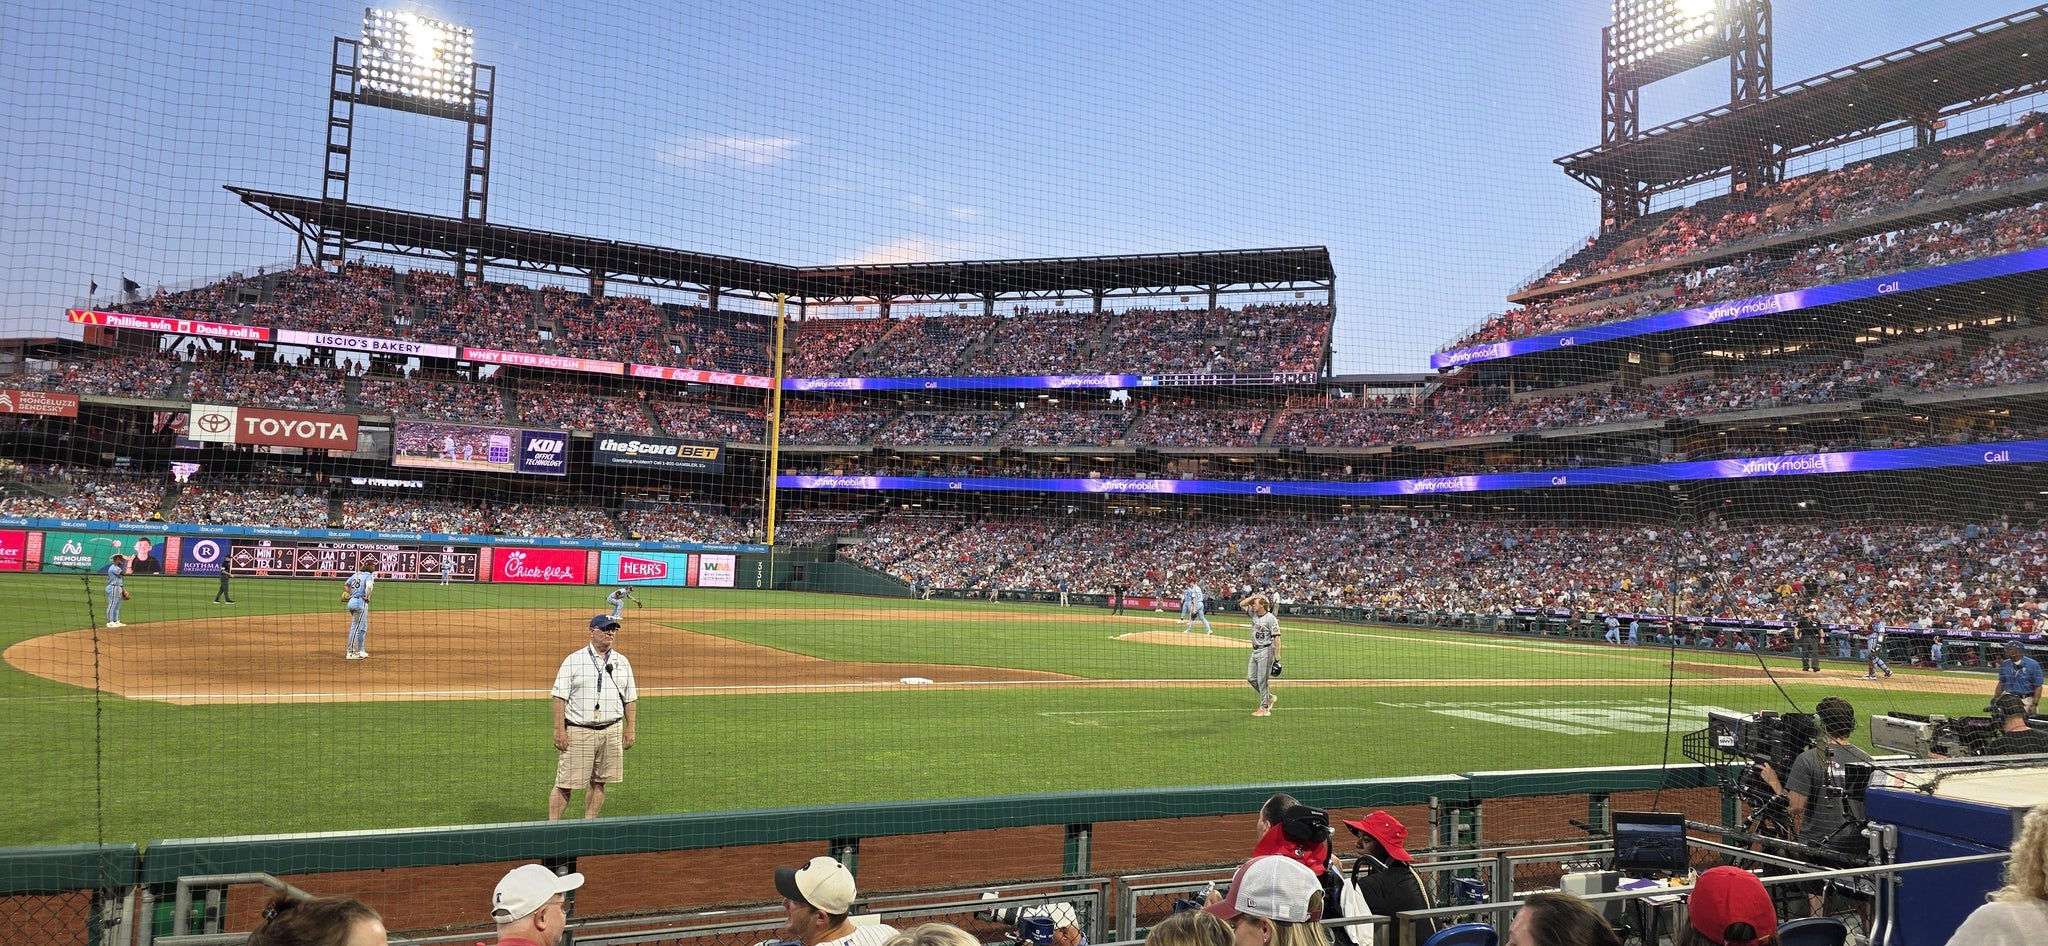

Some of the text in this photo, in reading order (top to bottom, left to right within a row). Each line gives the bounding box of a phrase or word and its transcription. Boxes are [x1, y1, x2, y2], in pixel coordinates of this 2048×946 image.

[1877, 281, 1900, 294] Call
[1708, 299, 1778, 321] xfinity mobile
[106, 315, 171, 330] Phillies win
[196, 324, 260, 339] Deals roll in
[315, 335, 422, 353] LISCIO'S BAKERY
[1559, 336, 1575, 346] Call
[468, 350, 499, 361] WHEY
[501, 353, 537, 365] BETTER
[538, 356, 579, 368] PROTEIN
[1449, 347, 1497, 364] xfinity mobile
[924, 381, 938, 389] Call
[20, 391, 46, 399] SALTZ
[19, 398, 76, 407] MONGELUZZI
[19, 403, 64, 413] BENDESKY
[244, 417, 349, 441] TOYOTA
[527, 438, 564, 454] KDI
[599, 439, 716, 458] theScore BET
[534, 453, 555, 461] OFFICE
[1983, 450, 2010, 463] Call
[525, 459, 563, 468] TECHNOLOGY
[1742, 456, 1824, 475] xfinity mobile
[812, 479, 837, 487] xfinity
[949, 482, 962, 490] Call
[1101, 481, 1158, 491] xfinity mobile
[1551, 476, 1567, 486] Call
[1255, 486, 1271, 494] Call
[1413, 482, 1438, 492] xfinity
[61, 520, 87, 529] ibx.com
[119, 522, 161, 531] Independence
[253, 528, 292, 536] Independence
[201, 547, 212, 556] R
[256, 549, 283, 558] MIN 9
[320, 551, 346, 560] LAA 0
[381, 552, 398, 562] CWS
[442, 555, 466, 564] BAL 0
[255, 560, 282, 569] TEX 3
[320, 561, 345, 570] ATH 0
[381, 563, 396, 572] NYY
[504, 554, 575, 580] Chick-fil-A
[623, 561, 662, 576] HERR'S
[704, 562, 730, 571] WM
[351, 578, 361, 589] 28
[1255, 632, 1265, 640] 63
